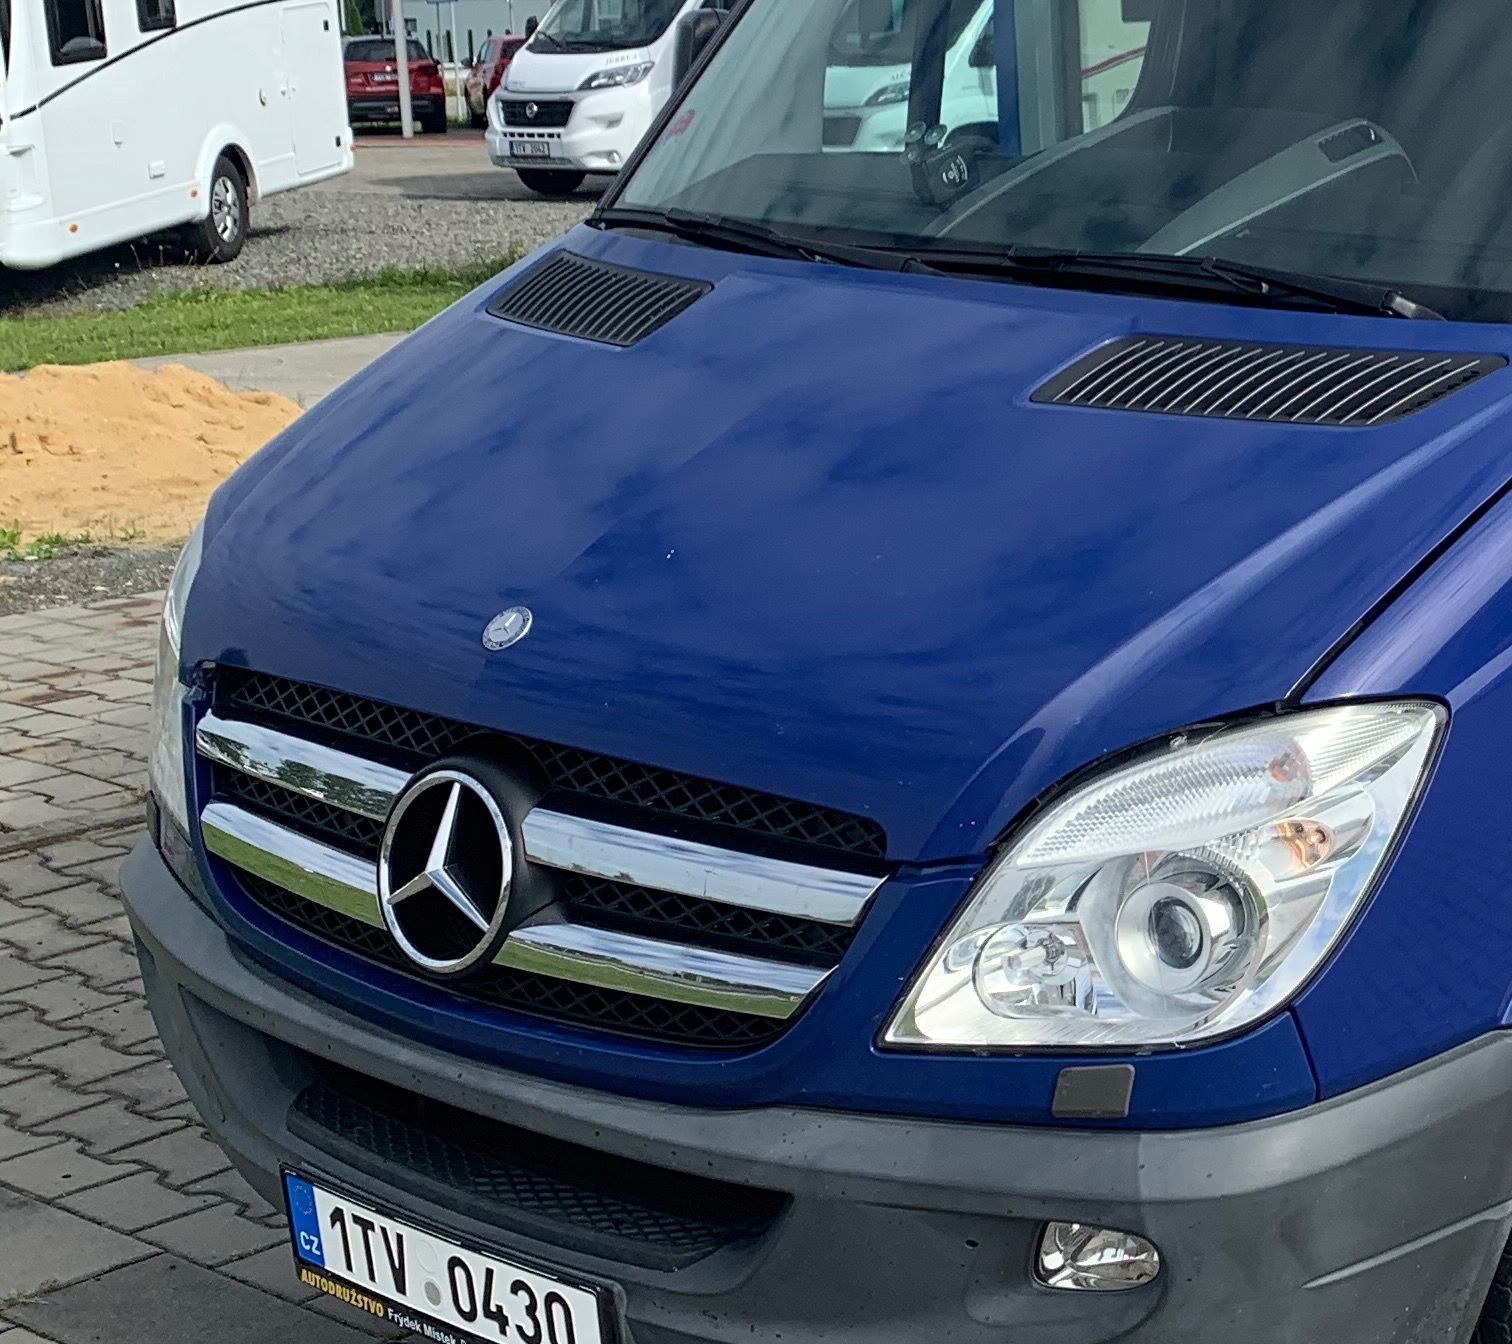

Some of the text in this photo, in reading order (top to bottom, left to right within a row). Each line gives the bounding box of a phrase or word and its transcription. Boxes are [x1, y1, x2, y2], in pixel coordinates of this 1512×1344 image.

[300, 1231, 321, 1256] CZ
[329, 1205, 407, 1297] 1TV
[301, 1268, 385, 1318] AUTODRUŽSTVO
[387, 1308, 422, 1334] Frýdek
